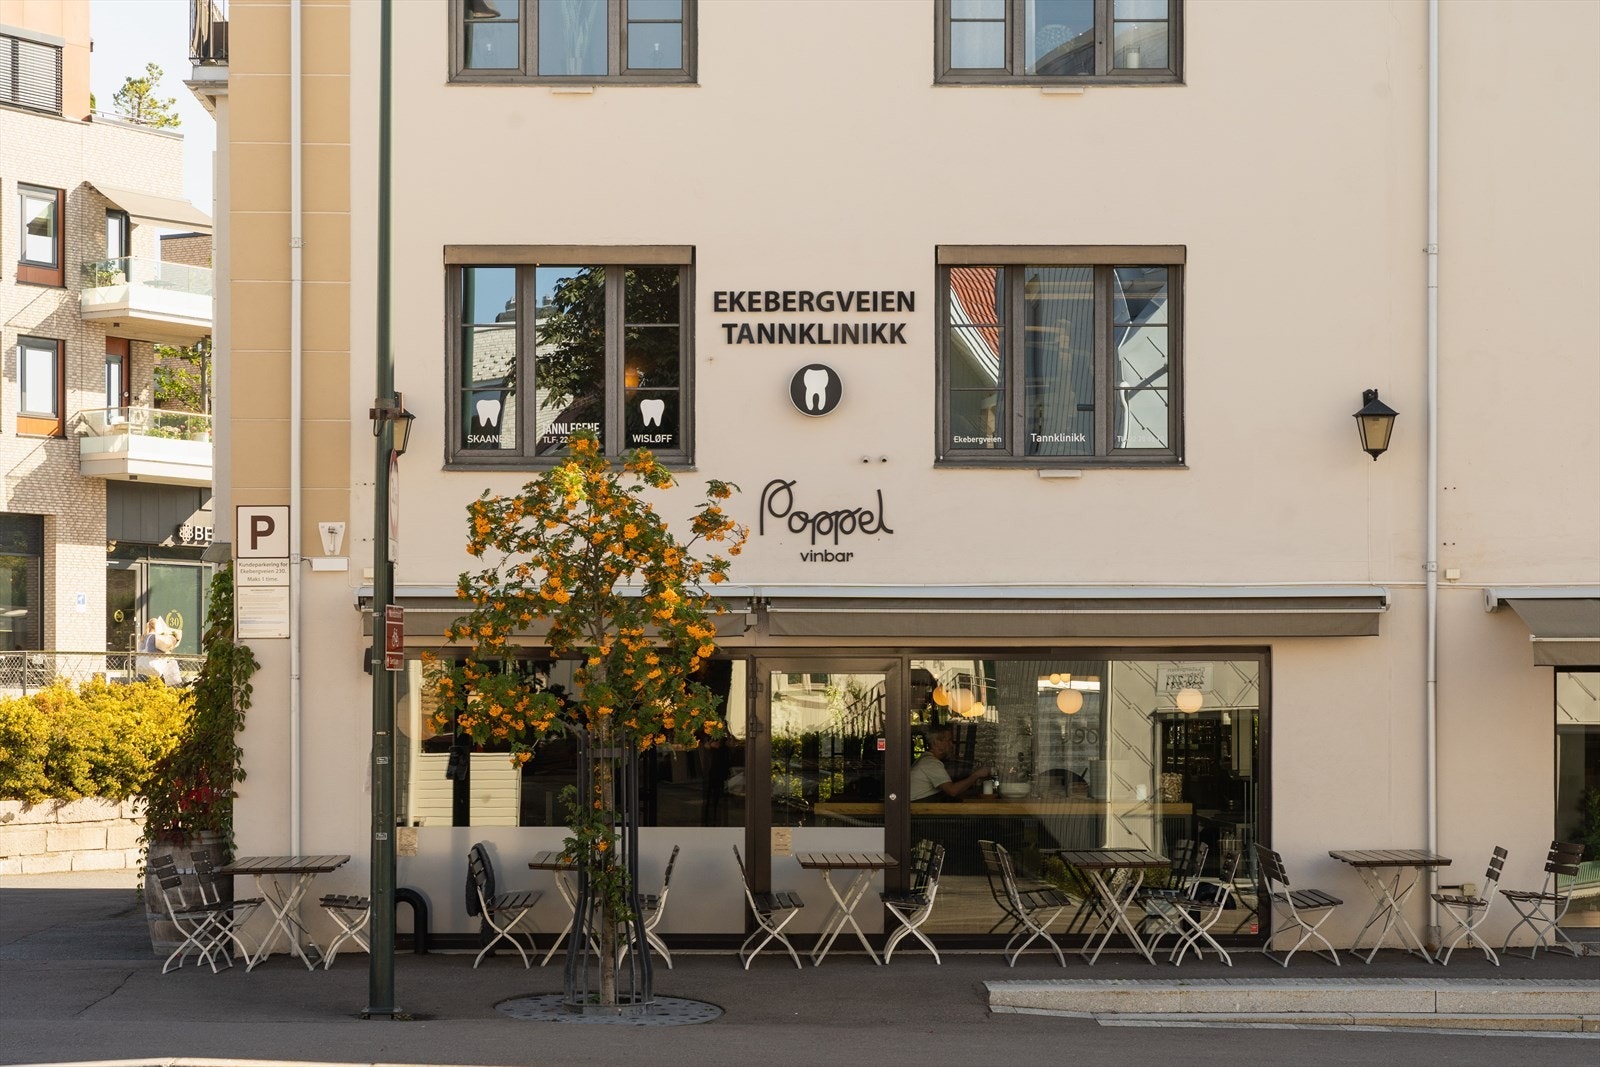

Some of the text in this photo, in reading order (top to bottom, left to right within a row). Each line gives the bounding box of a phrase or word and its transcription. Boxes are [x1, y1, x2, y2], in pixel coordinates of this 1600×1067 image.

[713, 290, 915, 313] EKEBERGVEIEN
[721, 322, 907, 345] TANNKLINIKK
[632, 434, 673, 443] WISLØFF
[953, 435, 1002, 445] Ekebergveien
[1030, 433, 1086, 443] Tannklinikk
[759, 479, 894, 545] Poppel
[250, 515, 275, 550] P
[800, 550, 854, 562] vinbar
